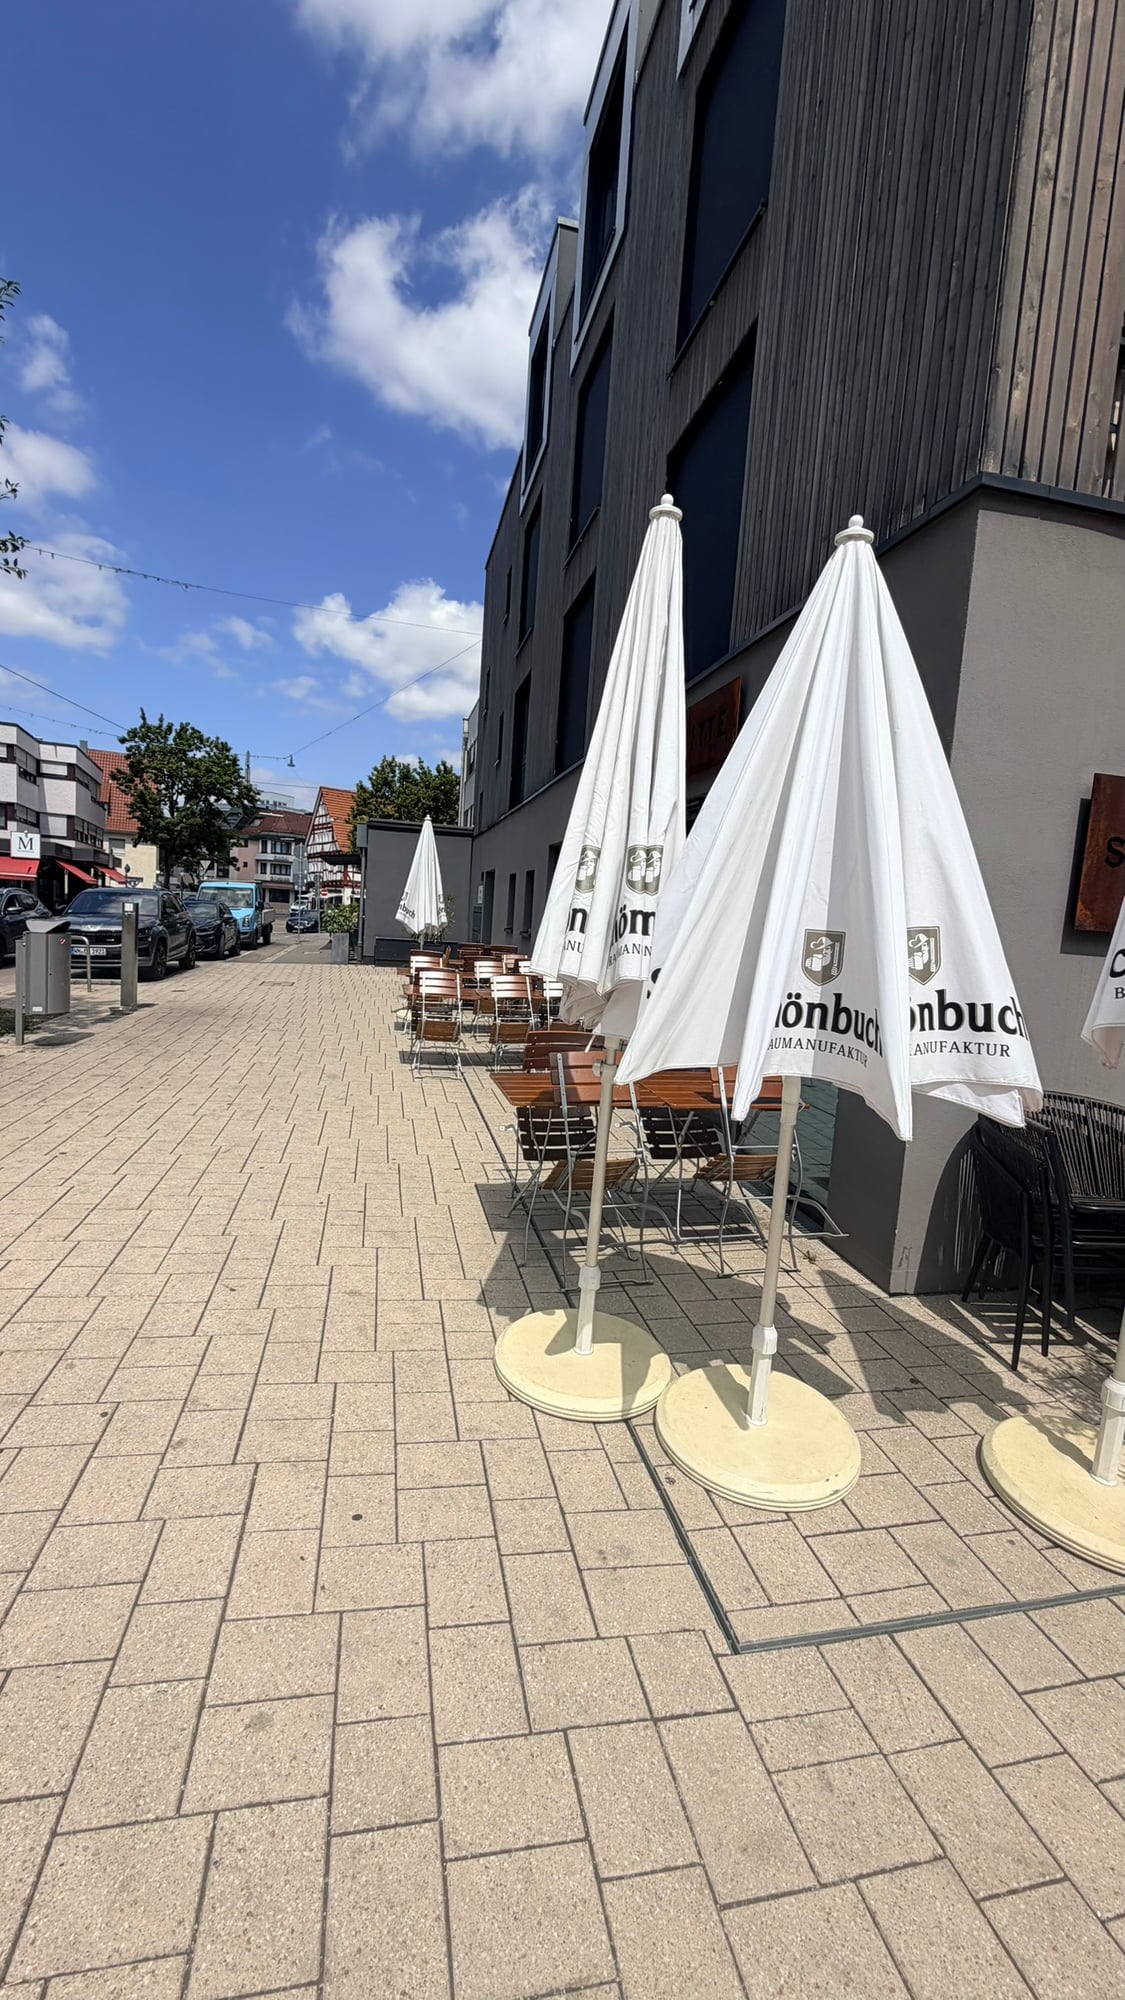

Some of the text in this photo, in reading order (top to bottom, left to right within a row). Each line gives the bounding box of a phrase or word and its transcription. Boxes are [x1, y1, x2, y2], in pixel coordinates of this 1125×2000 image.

[18, 836, 33, 850] M
[1104, 836, 1125, 868] S
[910, 1041, 1011, 1057] ANUFAKTUR
